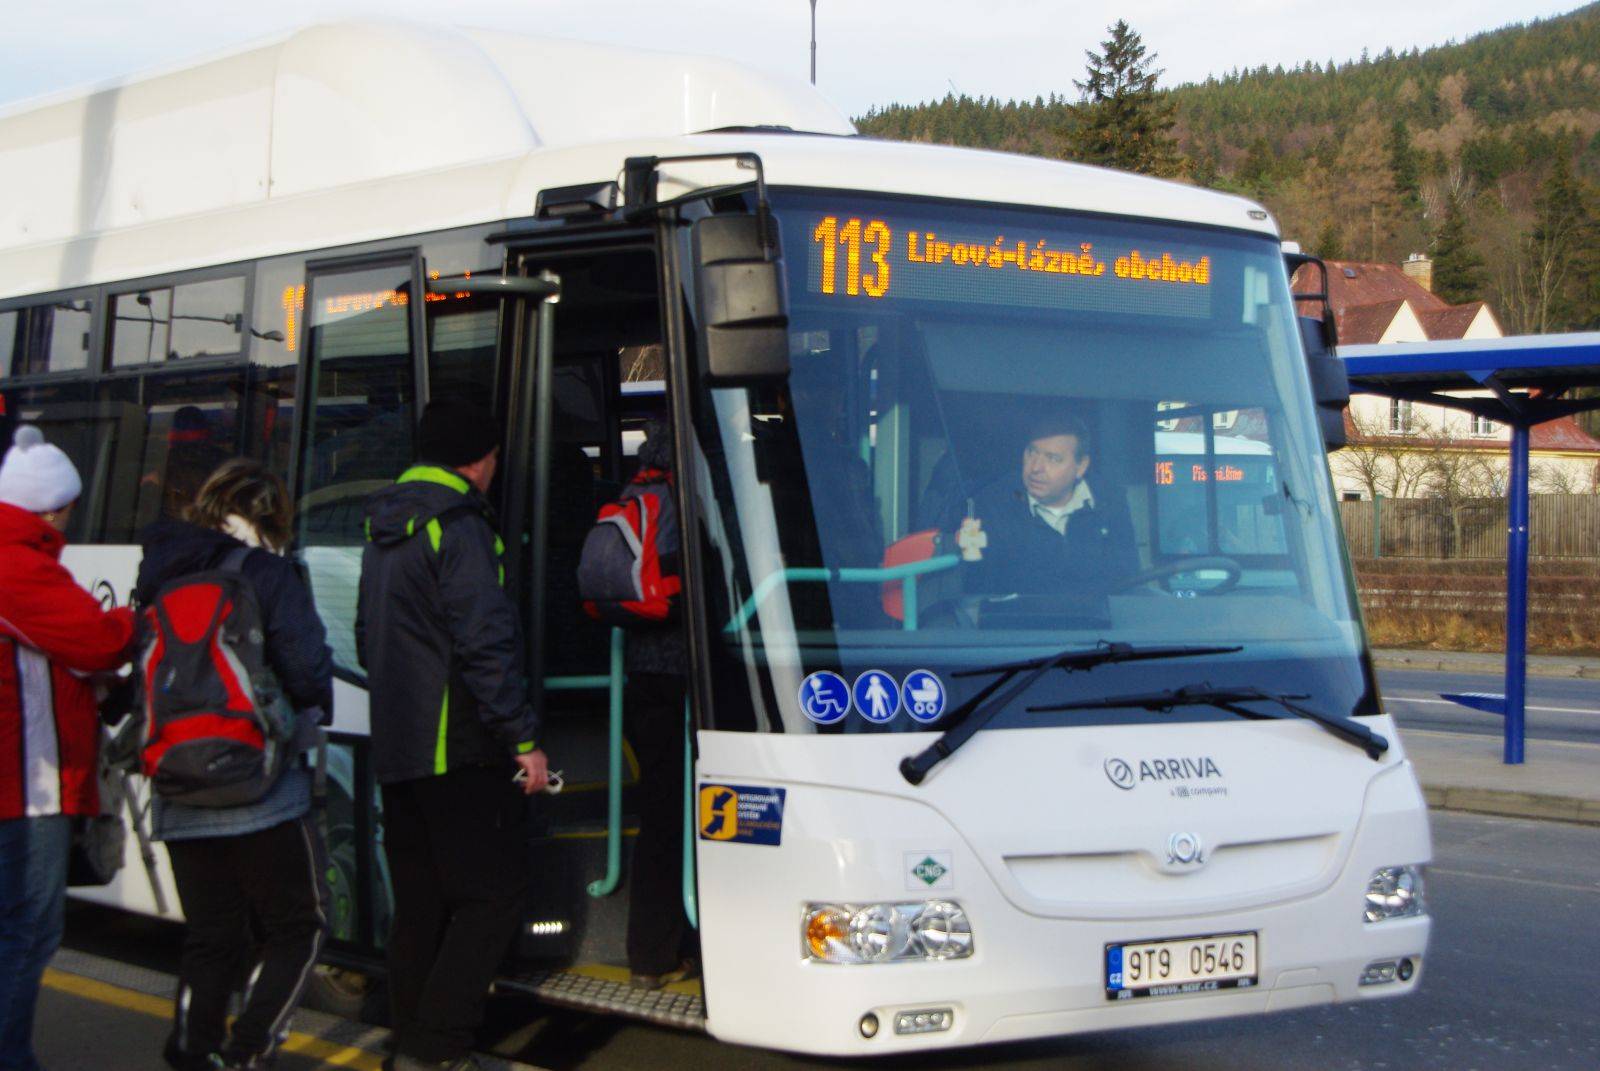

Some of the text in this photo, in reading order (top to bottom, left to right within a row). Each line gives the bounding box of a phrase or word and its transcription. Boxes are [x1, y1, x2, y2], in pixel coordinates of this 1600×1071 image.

[814, 216, 890, 297] 113
[1114, 250, 1210, 285] obchod
[1139, 757, 1222, 781] ARRIVA
[916, 864, 943, 878] CNG
[1129, 942, 1244, 981] 9T9 0546
[1109, 972, 1122, 984] CZ
